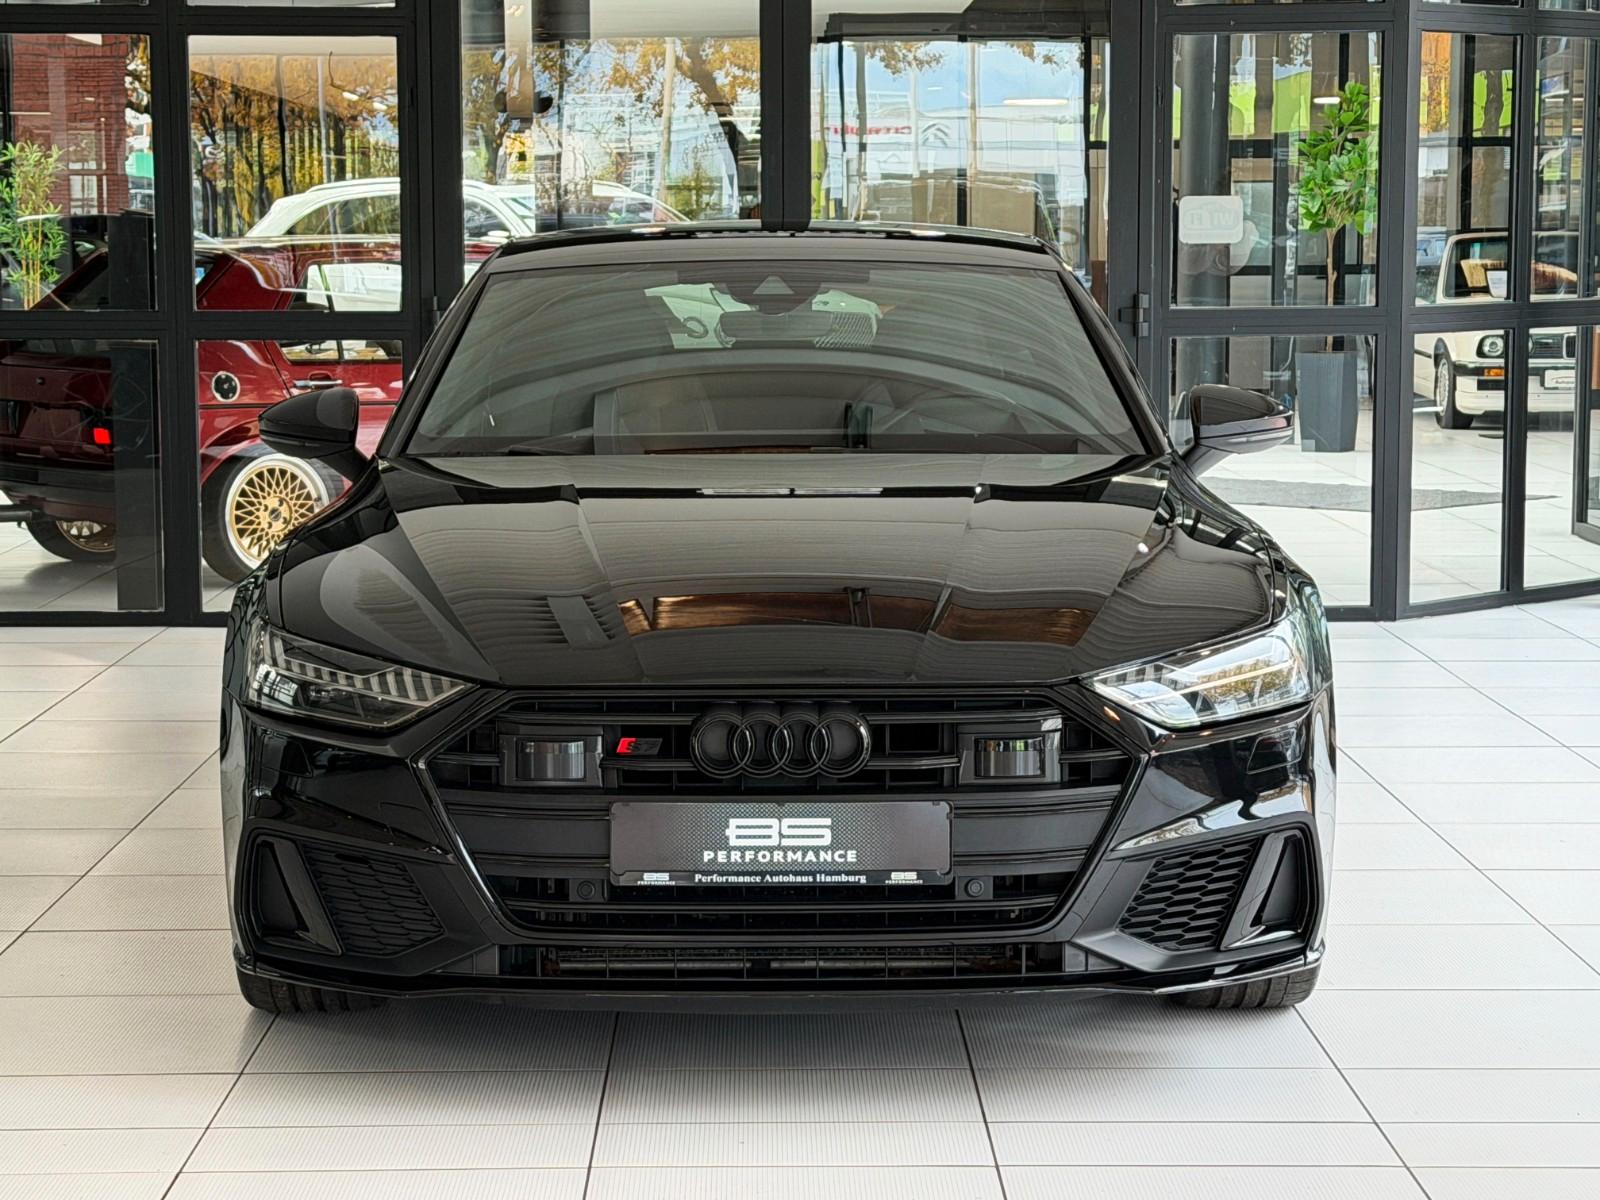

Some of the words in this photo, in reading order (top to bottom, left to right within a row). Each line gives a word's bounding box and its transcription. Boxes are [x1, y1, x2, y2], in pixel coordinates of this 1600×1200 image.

[725, 818, 832, 847] BS
[703, 850, 858, 863] PERFORMANCE
[694, 873, 762, 883] Performance
[764, 873, 814, 883] Autohaus
[816, 873, 867, 884] Hamburg
